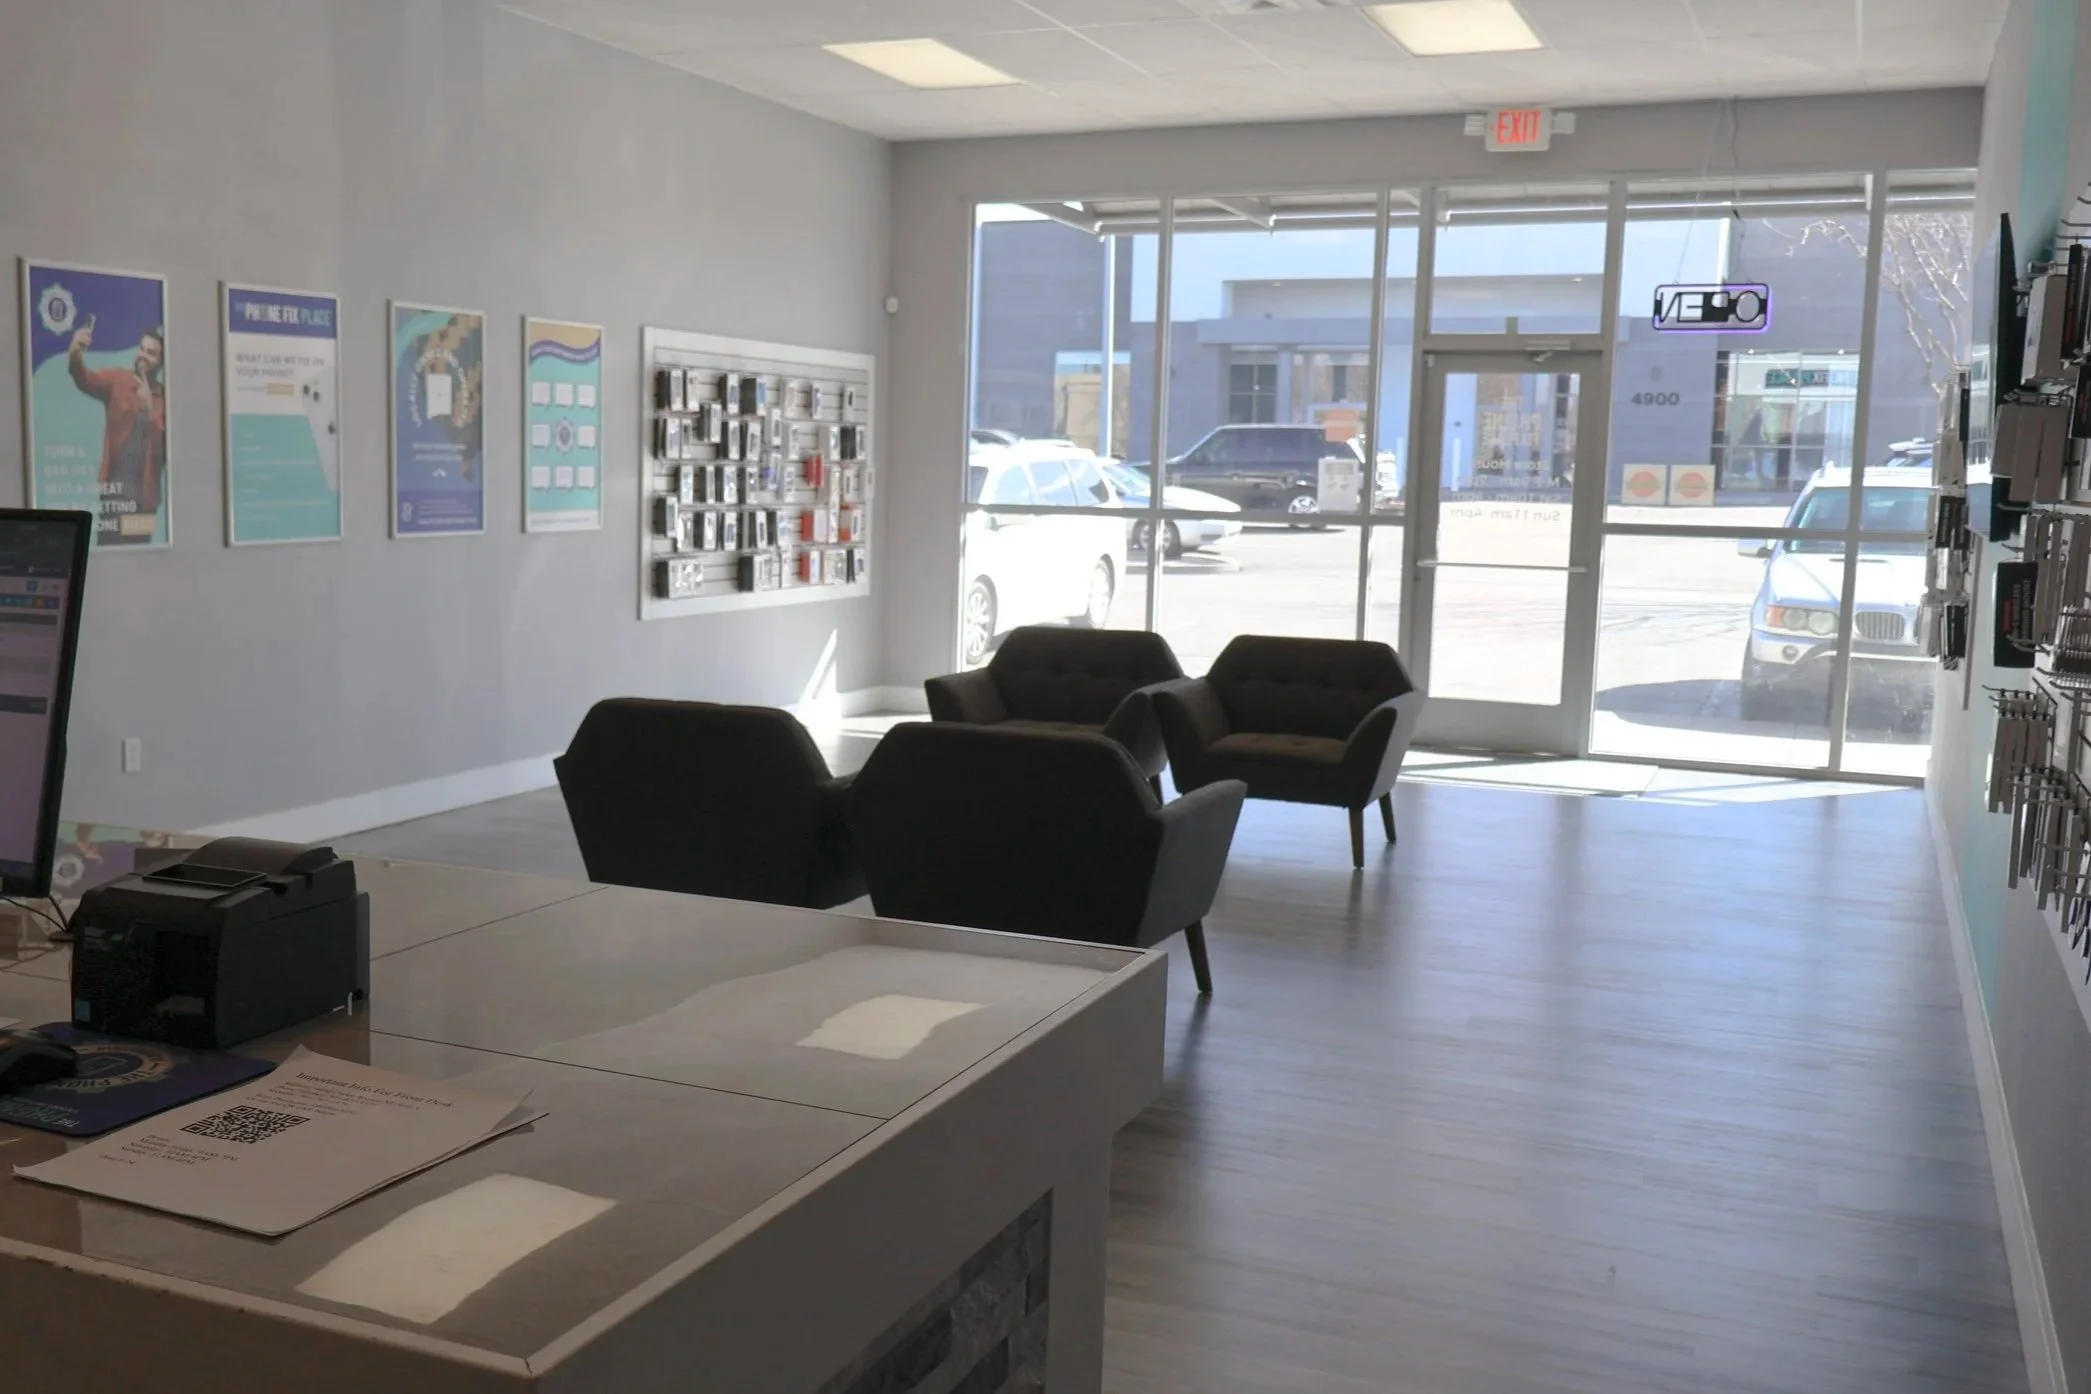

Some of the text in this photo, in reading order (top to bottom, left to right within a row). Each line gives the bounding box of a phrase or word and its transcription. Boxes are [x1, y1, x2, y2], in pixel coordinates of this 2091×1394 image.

[1496, 109, 1542, 144] EXIT
[300, 308, 331, 326] PLACE
[1631, 392, 1680, 406] 4900
[296, 1072, 348, 1088] Important
[348, 1083, 372, 1093] Info
[373, 1088, 395, 1097] For
